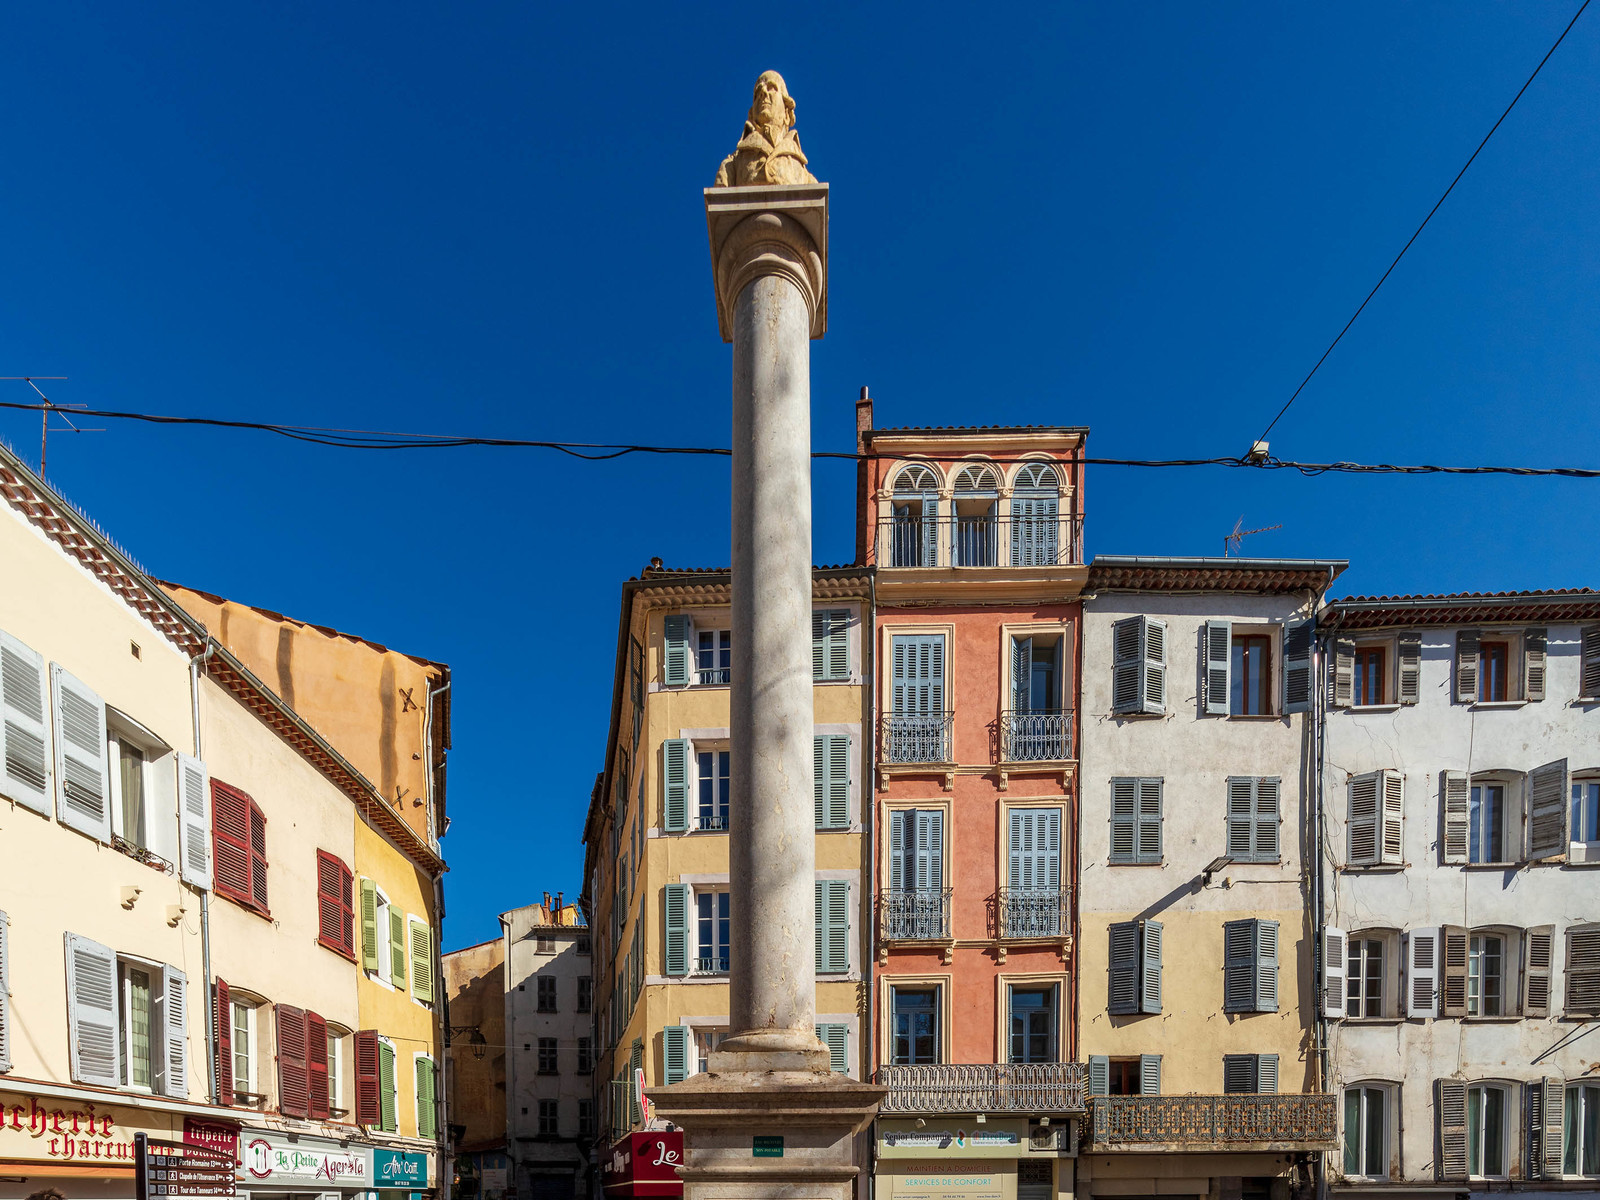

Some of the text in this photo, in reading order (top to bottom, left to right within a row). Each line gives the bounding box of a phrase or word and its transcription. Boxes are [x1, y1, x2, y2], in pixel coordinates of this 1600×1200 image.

[191, 1127, 233, 1143] triperie
[884, 1131, 951, 1143] Senior Compagnie
[47, 1133, 174, 1160] charcutrie
[652, 1141, 684, 1167] Le
[179, 1158, 192, 1166] Porte
[192, 1159, 210, 1168] Romaine
[275, 1151, 290, 1170] La
[290, 1152, 319, 1173] Petite
[953, 1178, 992, 1186] CONFORT
